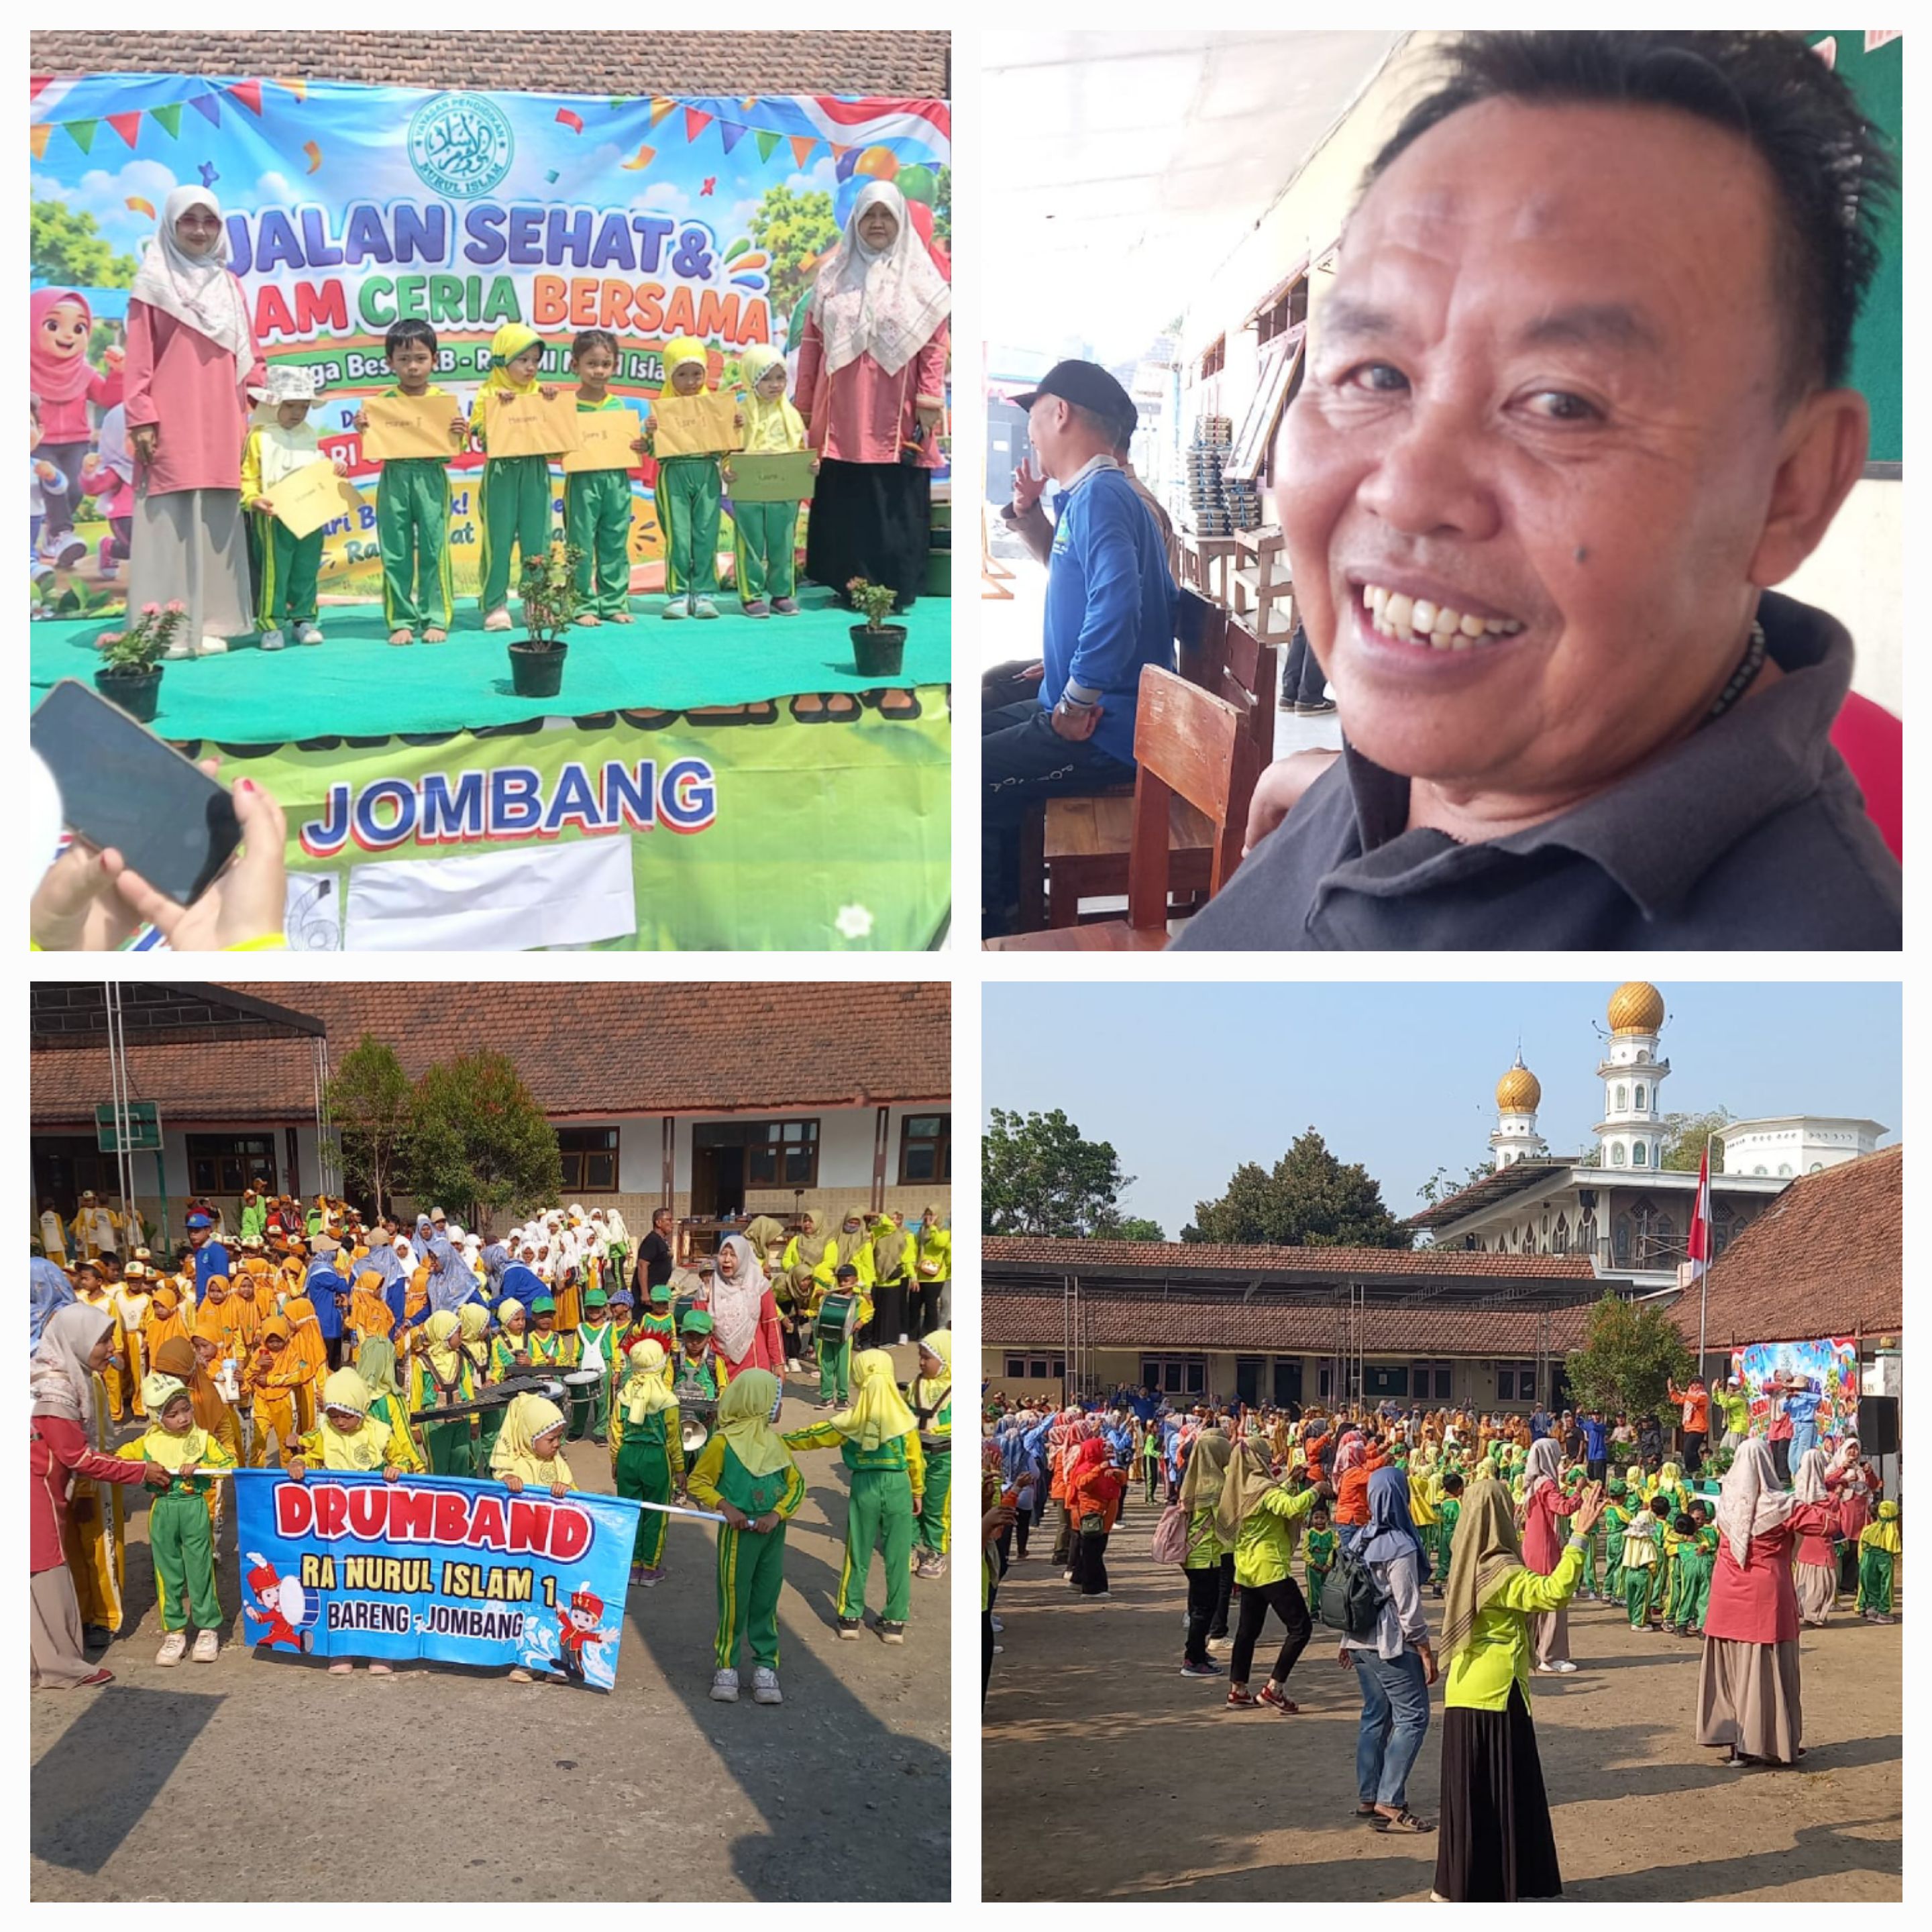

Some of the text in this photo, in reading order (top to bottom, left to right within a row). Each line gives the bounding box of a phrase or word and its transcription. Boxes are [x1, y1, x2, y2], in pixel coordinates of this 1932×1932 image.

[415, 99, 507, 138] YAYASAN PENDIDIKAN
[419, 162, 504, 193] NURUL ISLAM
[225, 204, 446, 278] JALAN
[358, 274, 521, 328] CERIA
[533, 274, 770, 345] BERSAMA
[630, 356, 665, 380] Isla
[301, 759, 716, 855] JOMBANG
[275, 1484, 591, 1560] DRUMBAND
[302, 1554, 556, 1607] RA NURUL ISLAM 1
[327, 1601, 409, 1633] BARENG
[425, 1605, 524, 1640] JOMBANG
